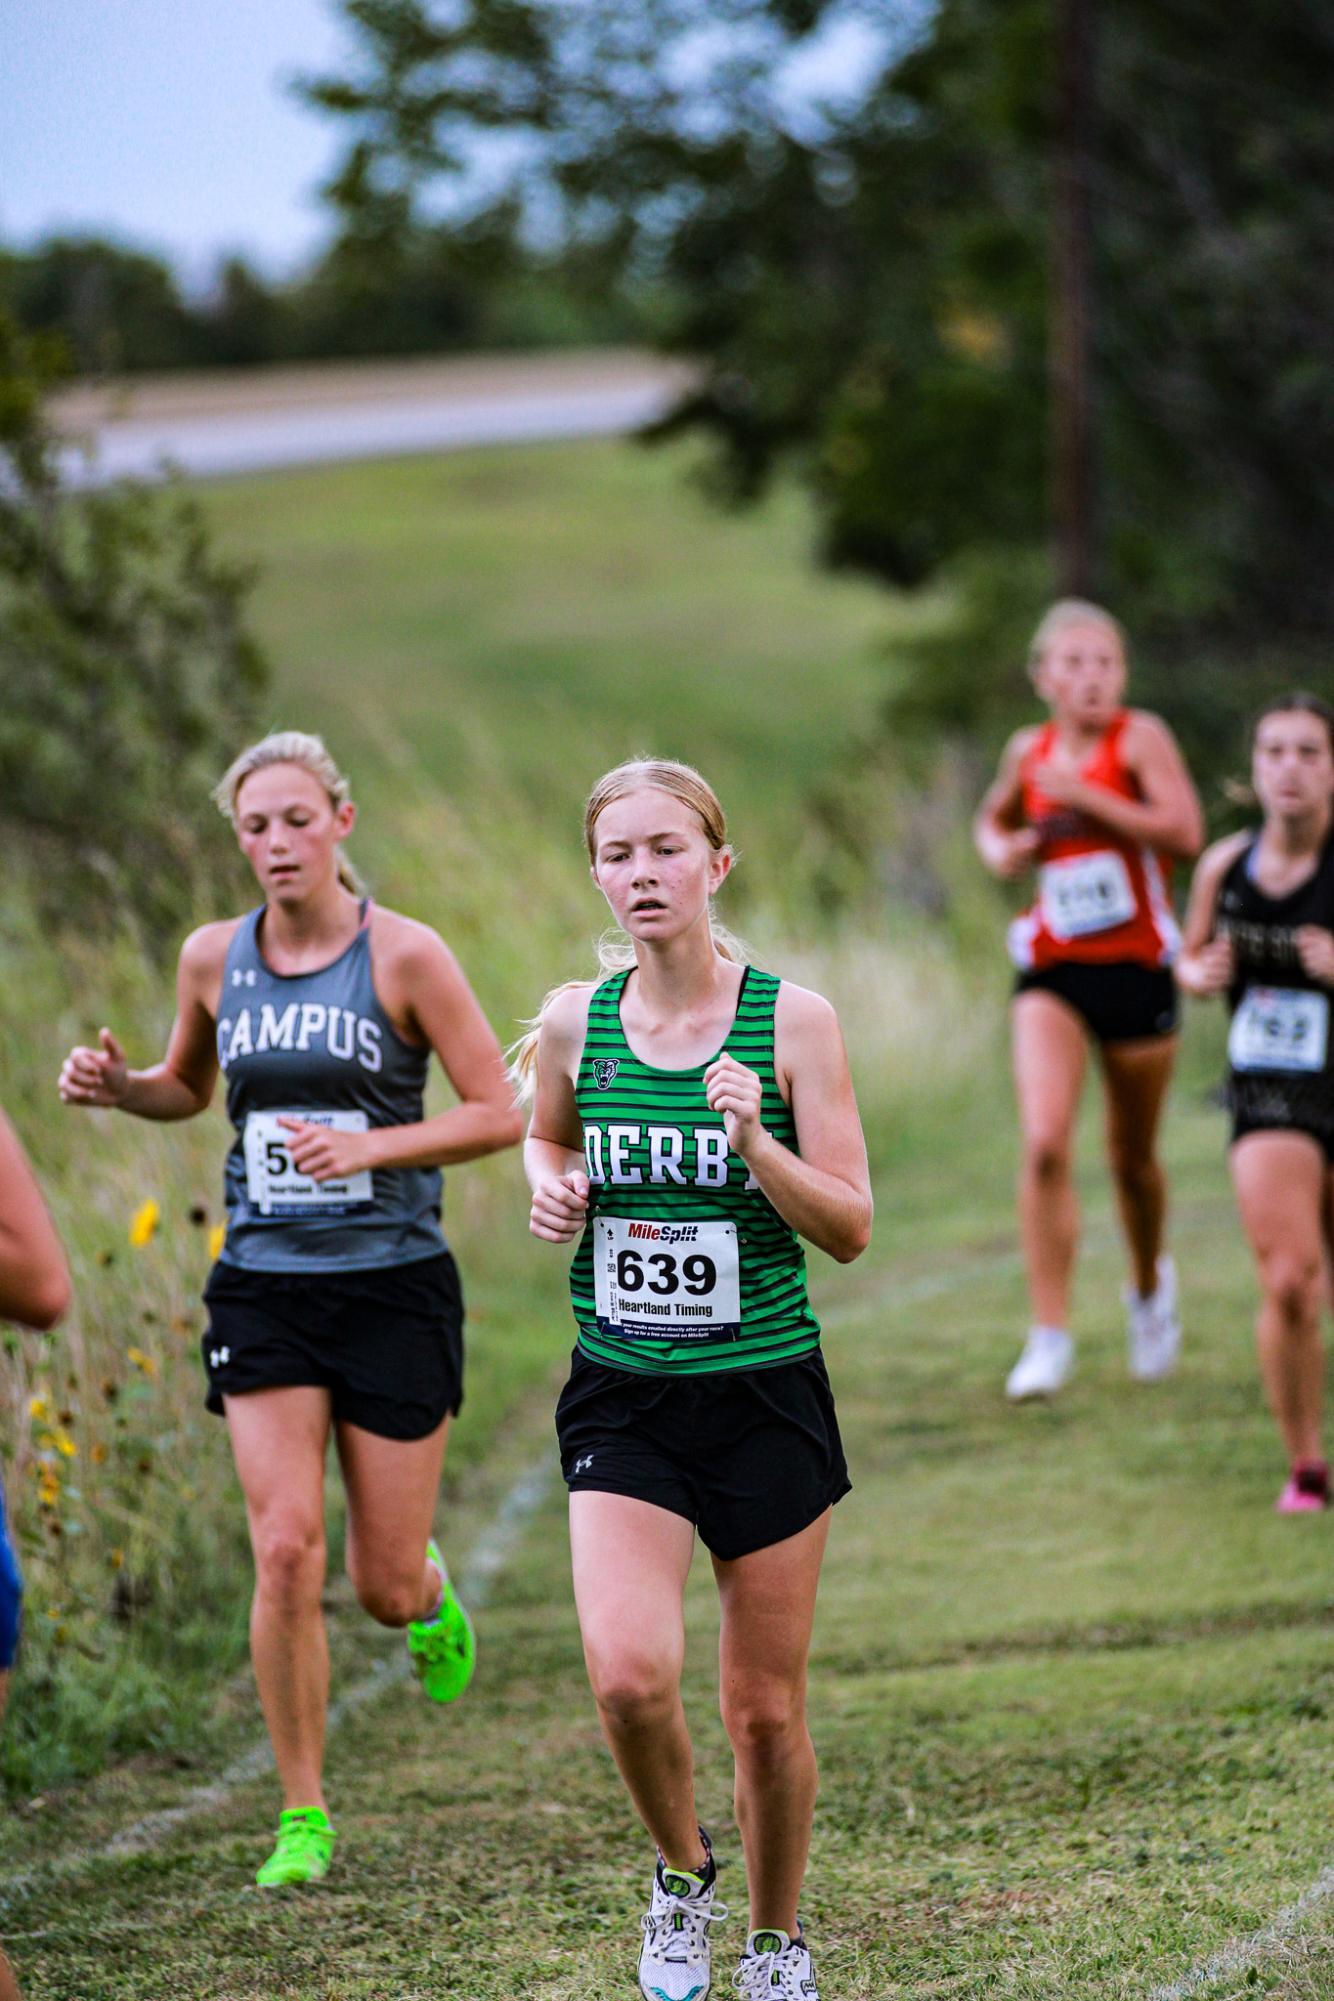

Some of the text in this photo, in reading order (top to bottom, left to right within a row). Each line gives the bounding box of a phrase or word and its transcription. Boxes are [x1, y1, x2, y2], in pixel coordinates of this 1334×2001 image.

[217, 1003, 382, 1073] CAMPUS
[583, 1124, 773, 1190] DERB
[628, 1223, 698, 1244] MileSplit
[617, 1250, 716, 1296] 639
[618, 1299, 671, 1315] Heartland
[674, 1303, 713, 1317] Timing
